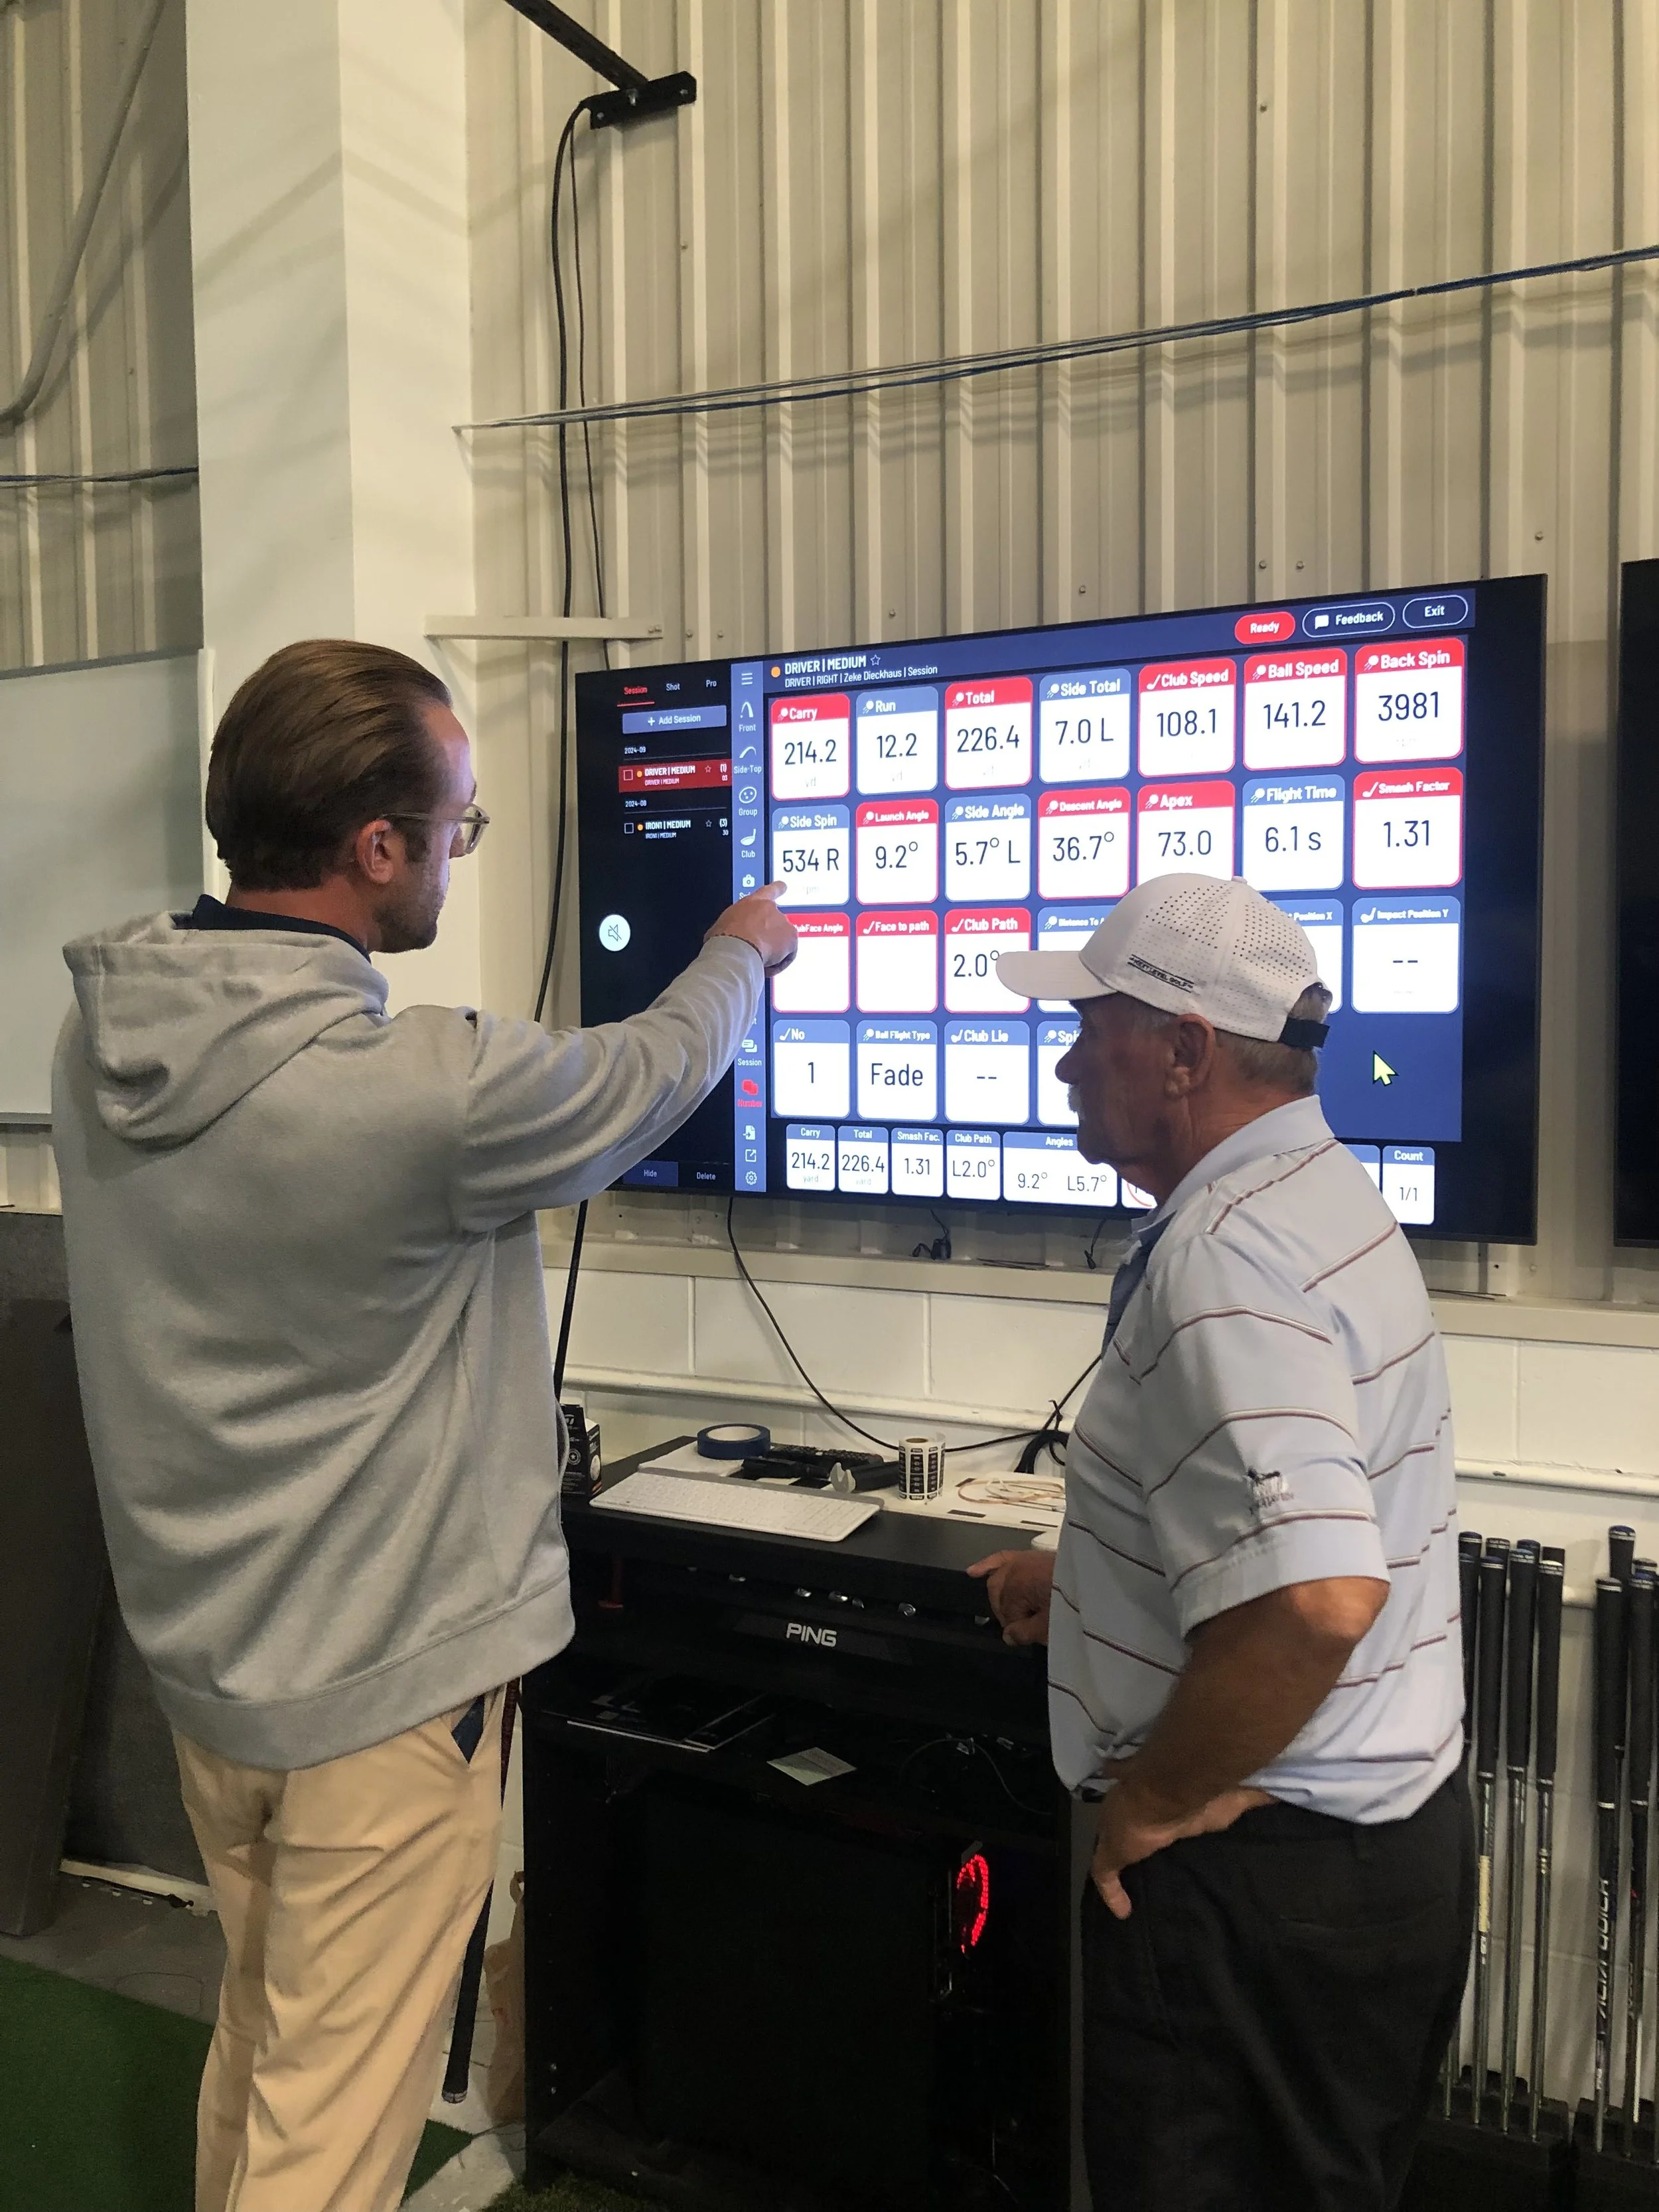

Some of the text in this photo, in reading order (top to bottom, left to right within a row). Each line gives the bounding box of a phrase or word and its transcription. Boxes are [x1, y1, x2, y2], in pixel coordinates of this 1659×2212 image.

[1335, 611, 1384, 625] Feedback
[1425, 605, 1445, 617] Exit
[1250, 621, 1279, 634] Ready
[785, 660, 820, 675] DRIVER
[828, 656, 867, 671] MEDIUM
[1380, 650, 1450, 669] Back Spin
[785, 677, 811, 688] DRIVER
[817, 674, 838, 685] RIGHT
[844, 673, 862, 683] Zeke
[863, 669, 902, 680] Dieckhaus
[908, 665, 938, 675] Session
[1268, 659, 1339, 679] Ball Speed
[1161, 669, 1229, 688] Club Speed
[624, 686, 648, 695] Session
[1060, 679, 1121, 697] Side Total
[966, 690, 995, 705] Total
[875, 700, 896, 712] Run
[1378, 692, 1438, 721] 3981
[658, 716, 672, 725] Add
[674, 714, 701, 723] Session
[790, 707, 818, 721] Carry
[1263, 700, 1325, 729] 141.2
[1157, 708, 1216, 737] 108.1
[1055, 717, 1114, 745] 7.0 L
[877, 733, 917, 759] 12.2
[957, 725, 1020, 753] 226.4
[784, 739, 837, 765] 214.2
[644, 767, 667, 776] DRIVER
[672, 765, 695, 774] MEDIUM
[1266, 786, 1337, 804] Flight Time
[1378, 781, 1450, 794] Smash Factor
[1059, 799, 1122, 812] Descent Angle
[1160, 794, 1192, 810] Apex
[739, 808, 758, 817] Group
[875, 810, 929, 822] Launch Angle
[965, 803, 1025, 820] Side Angle
[667, 820, 691, 830] MEDIUM
[790, 814, 837, 830] Side Spin
[1265, 826, 1321, 852] 6.1 s
[1383, 820, 1429, 848] 1.31
[1052, 832, 1114, 861] 36.7°
[1158, 830, 1211, 857] 73.0
[875, 842, 918, 869] 9.2°
[956, 838, 1021, 866] 5.7° L
[782, 848, 839, 873] 534 R
[1327, 911, 1333, 921] X
[1442, 909, 1449, 918] Y
[823, 923, 843, 934] Angle
[875, 921, 930, 933] Face to path
[964, 917, 1018, 931] Club Path
[1089, 917, 1099, 926] To
[791, 1028, 805, 1041] No
[875, 1031, 930, 1041] Ball Flight Type
[964, 1029, 1009, 1043] Club Lie
[808, 1062, 814, 1084] 1
[871, 1063, 923, 1086] Fade
[737, 1099, 762, 1108] Number
[800, 1128, 820, 1138] Carry
[853, 1130, 872, 1139] Total
[897, 1132, 940, 1142] Smash Fac.
[955, 1133, 992, 1143] Club Path
[1045, 1137, 1074, 1148] Angles
[792, 1151, 830, 1170] 214.2
[1394, 1150, 1424, 1161] Count
[841, 1155, 885, 1173] 226.4
[904, 1157, 930, 1175] 1.31
[952, 1159, 995, 1178] L2.0°
[803, 1175, 819, 1183] yard
[1017, 1172, 1107, 1192] 9.2° L5.7°
[1400, 1187, 1417, 1201] 1/1
[786, 1623, 837, 1647] PING
